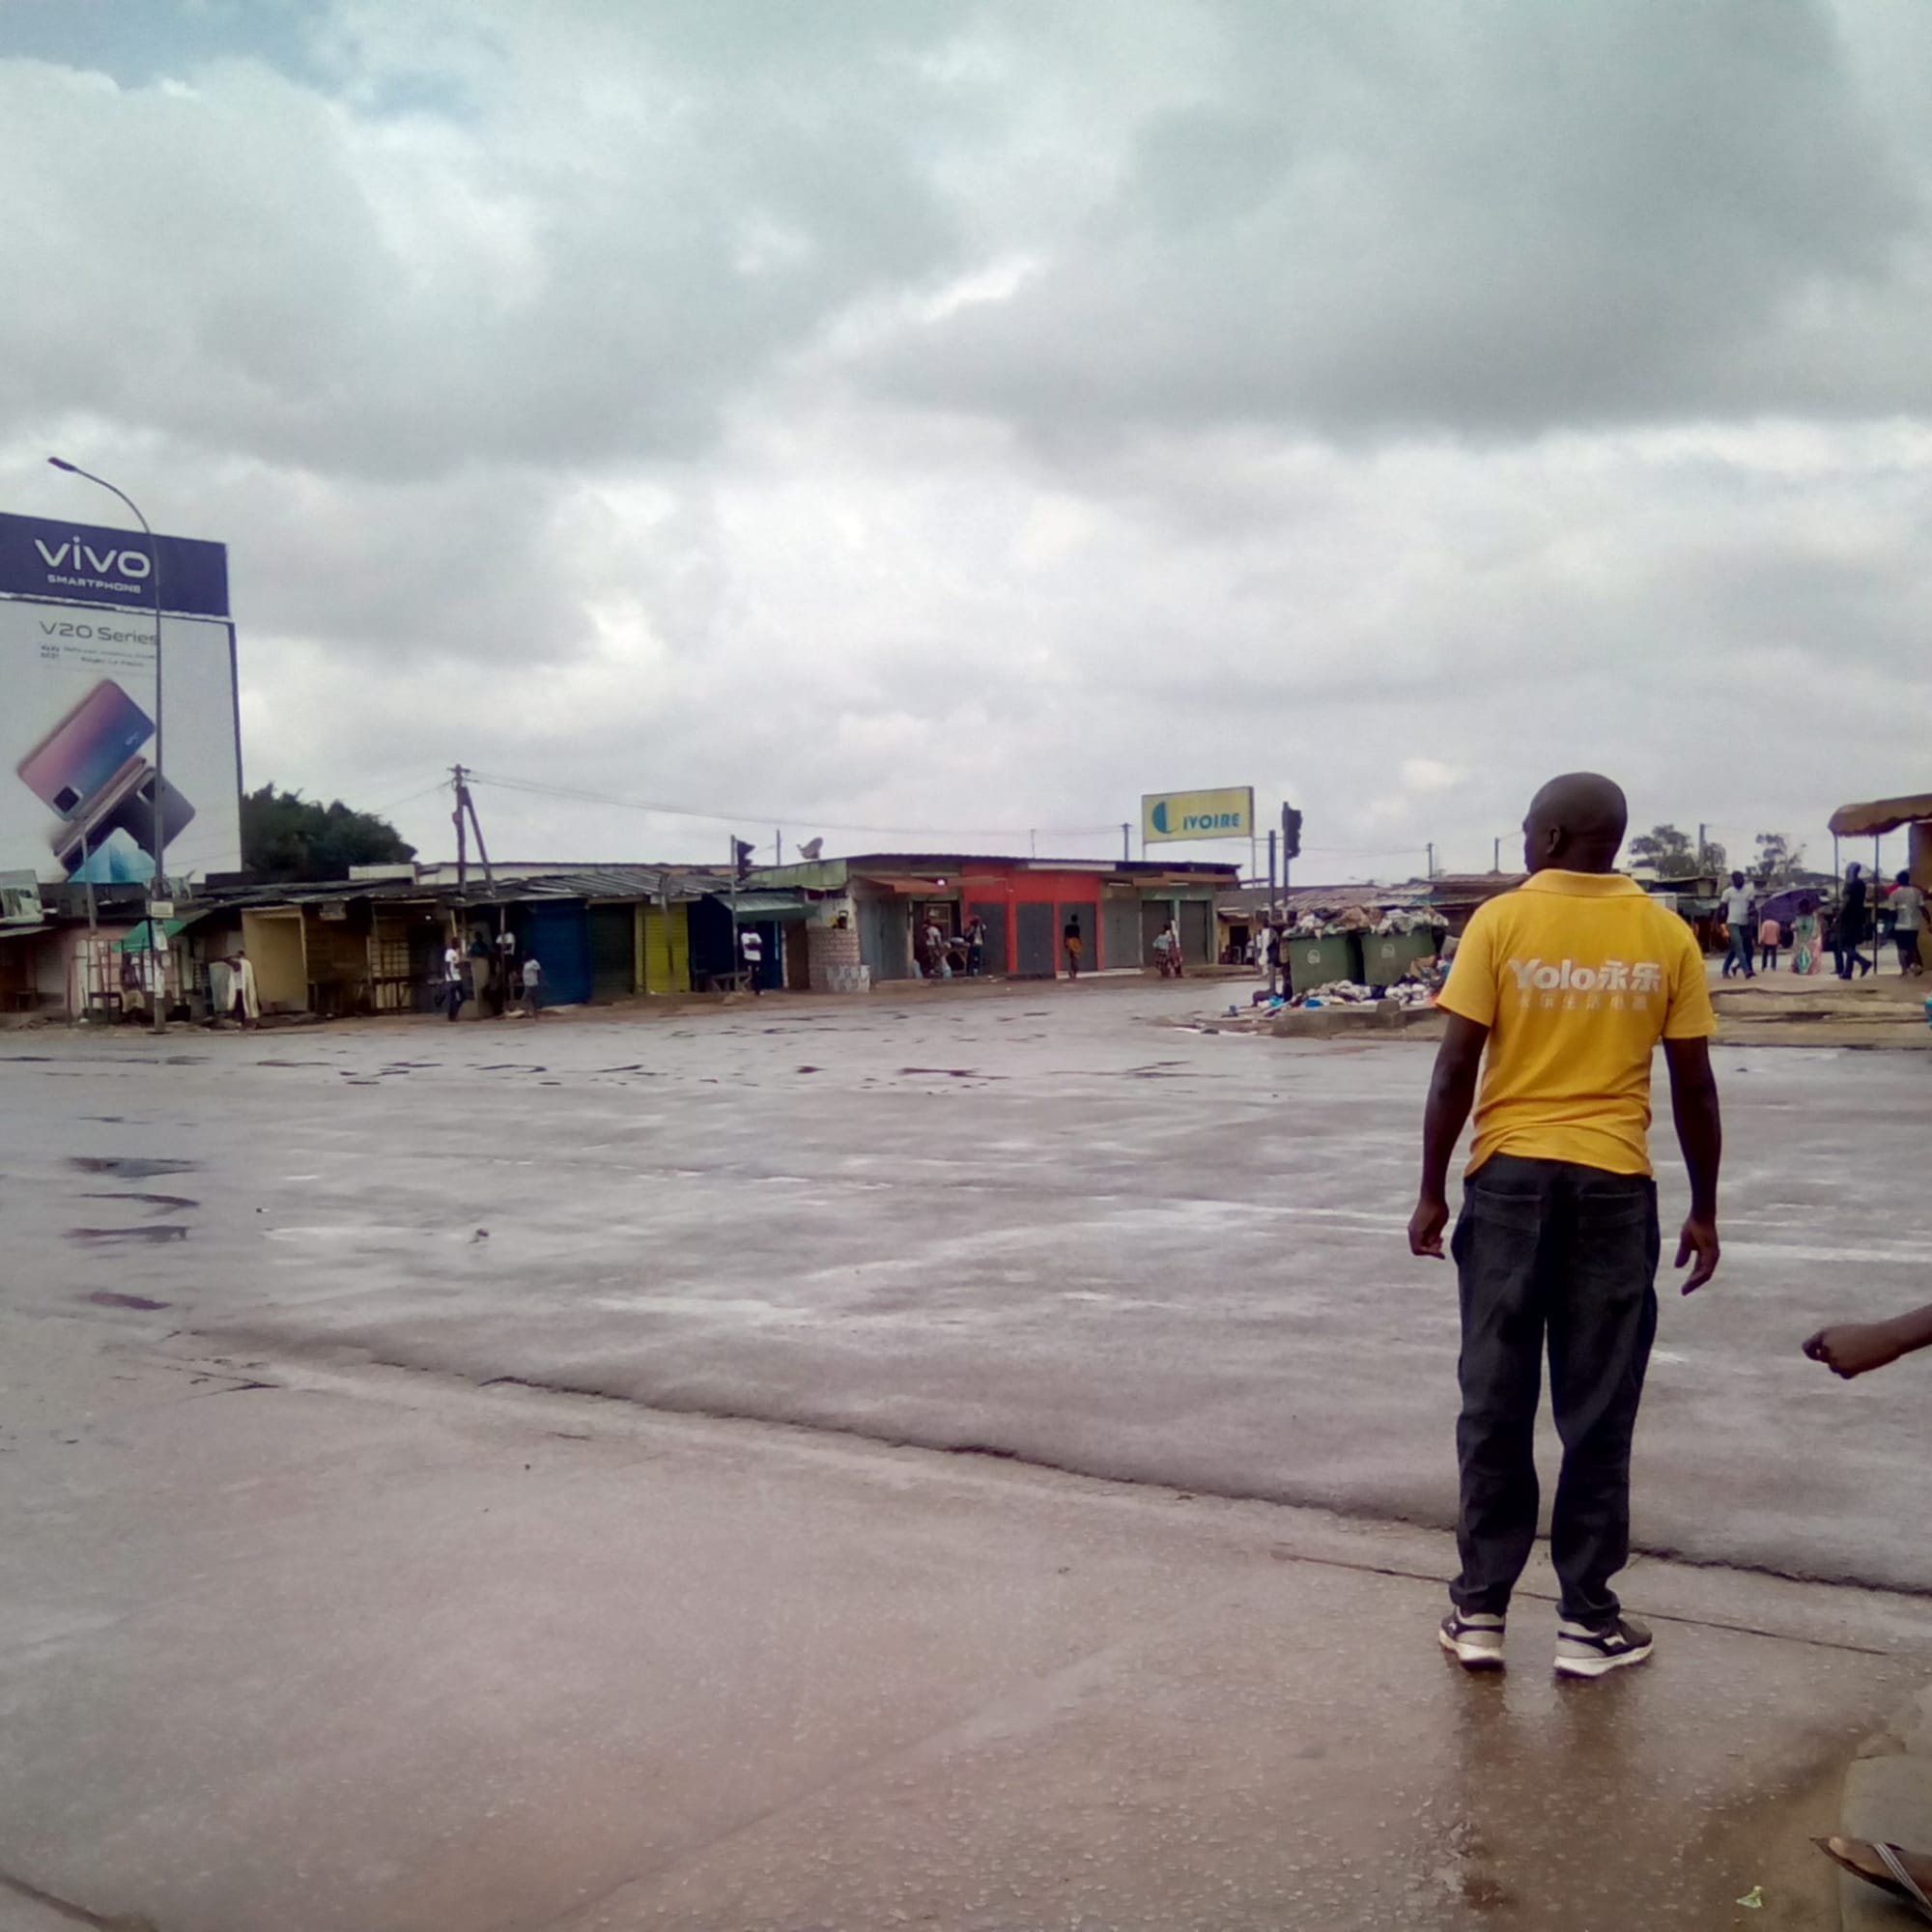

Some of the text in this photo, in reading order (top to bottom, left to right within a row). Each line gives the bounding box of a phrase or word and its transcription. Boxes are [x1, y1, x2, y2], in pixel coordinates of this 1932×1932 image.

[34, 535, 152, 579] vivo
[46, 574, 142, 594] SMARTPHONE
[39, 620, 158, 646] V20 Series
[1182, 812, 1240, 831] IVOIRE
